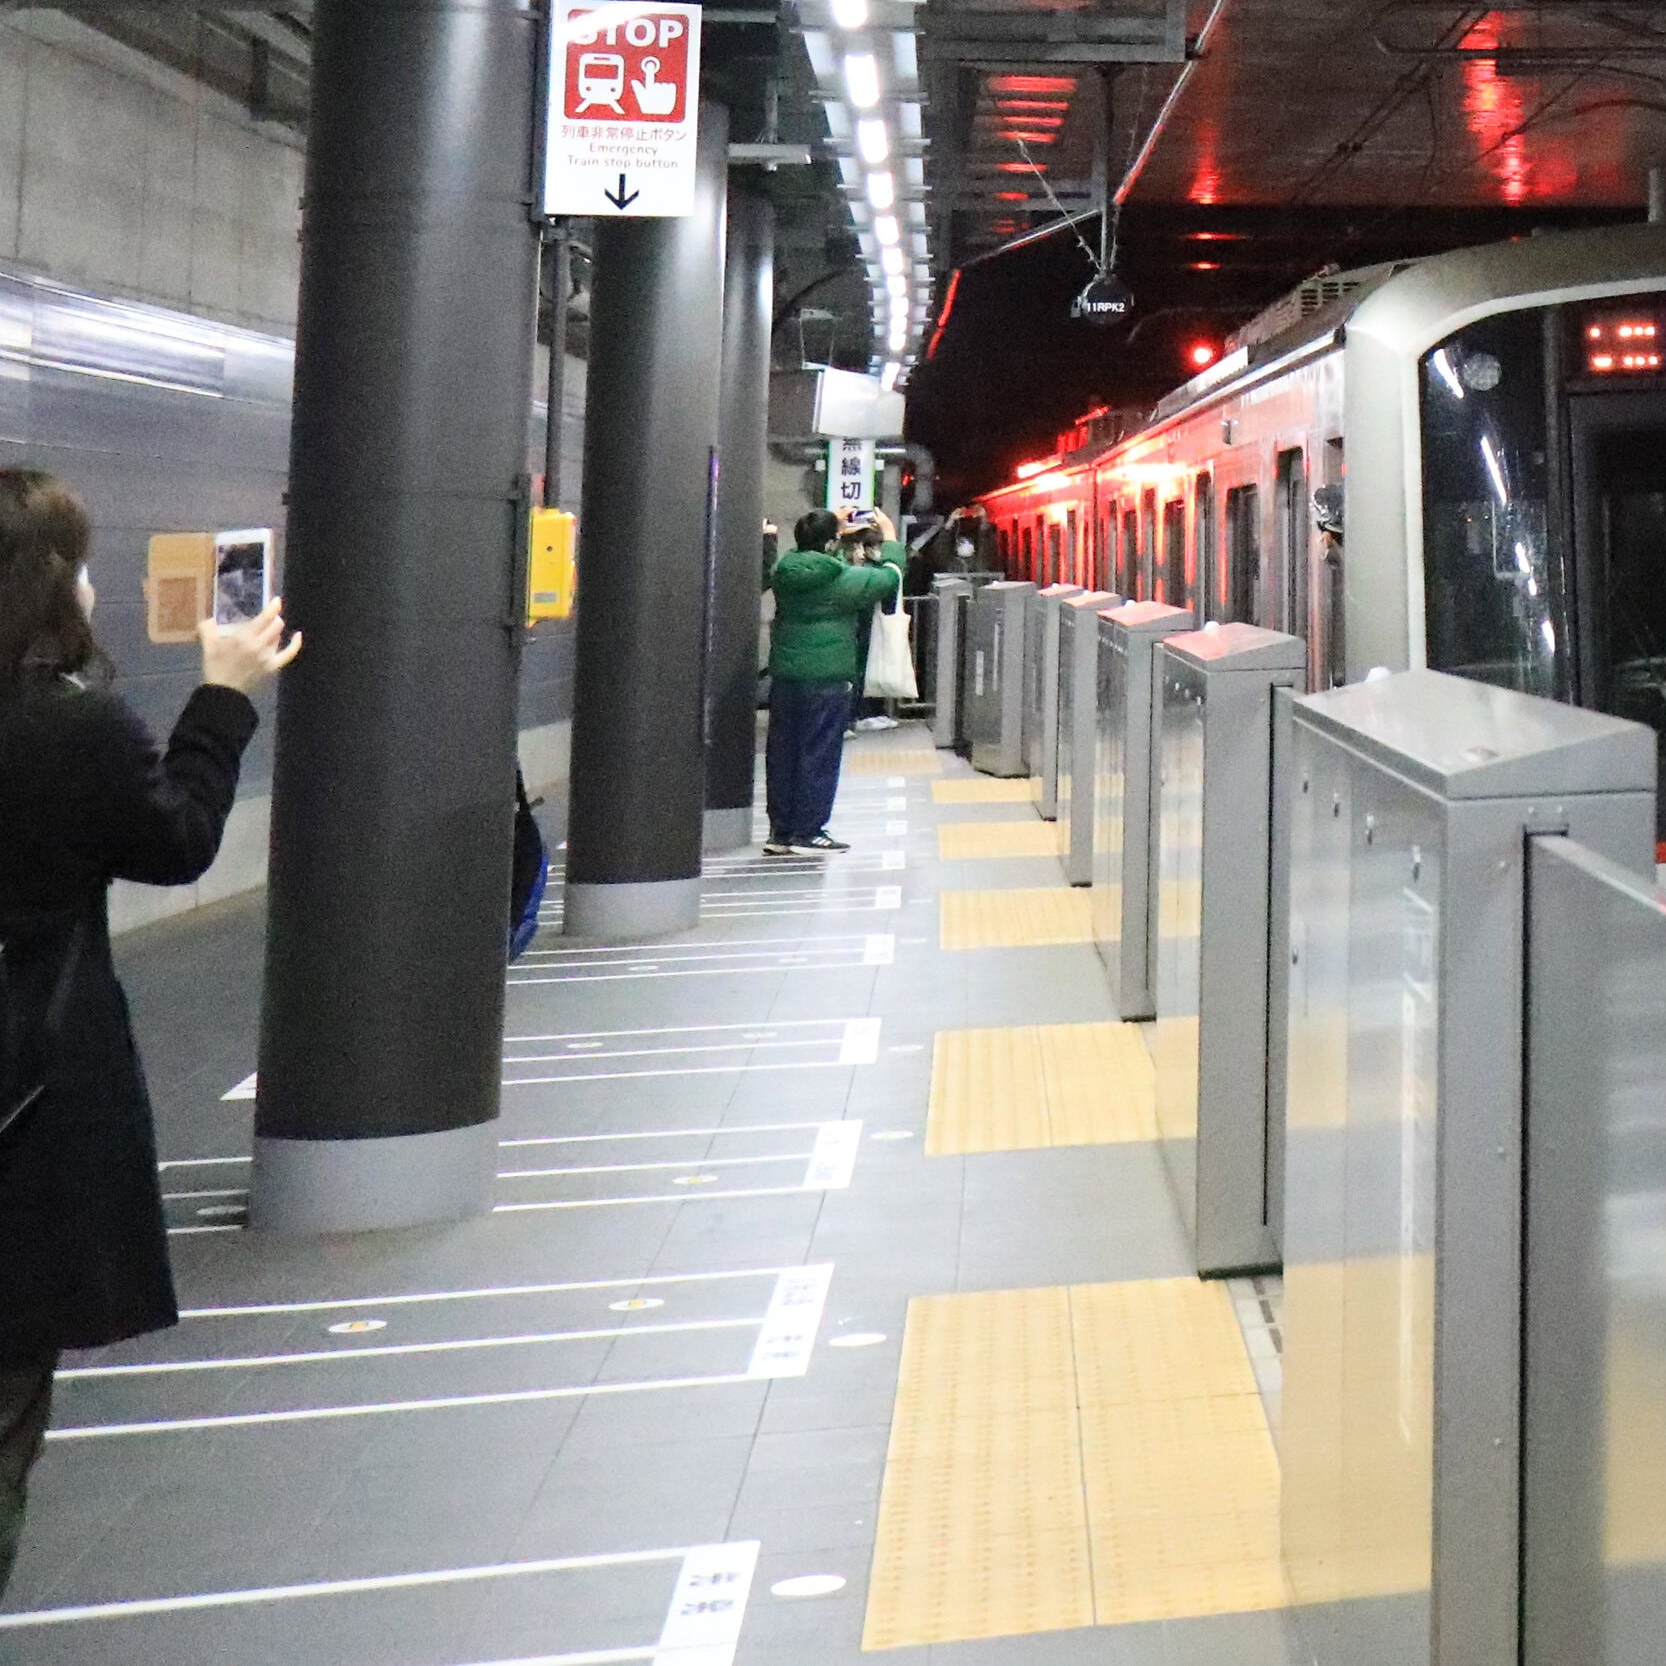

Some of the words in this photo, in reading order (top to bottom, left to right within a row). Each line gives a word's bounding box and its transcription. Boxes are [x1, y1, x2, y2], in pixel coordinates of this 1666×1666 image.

[561, 124, 688, 142] 列車非常停止ボタン
[589, 142, 657, 156] Emergency
[567, 154, 599, 166] Train
[604, 157, 632, 169] stop
[636, 158, 679, 169] button
[841, 438, 862, 509] 無線切
